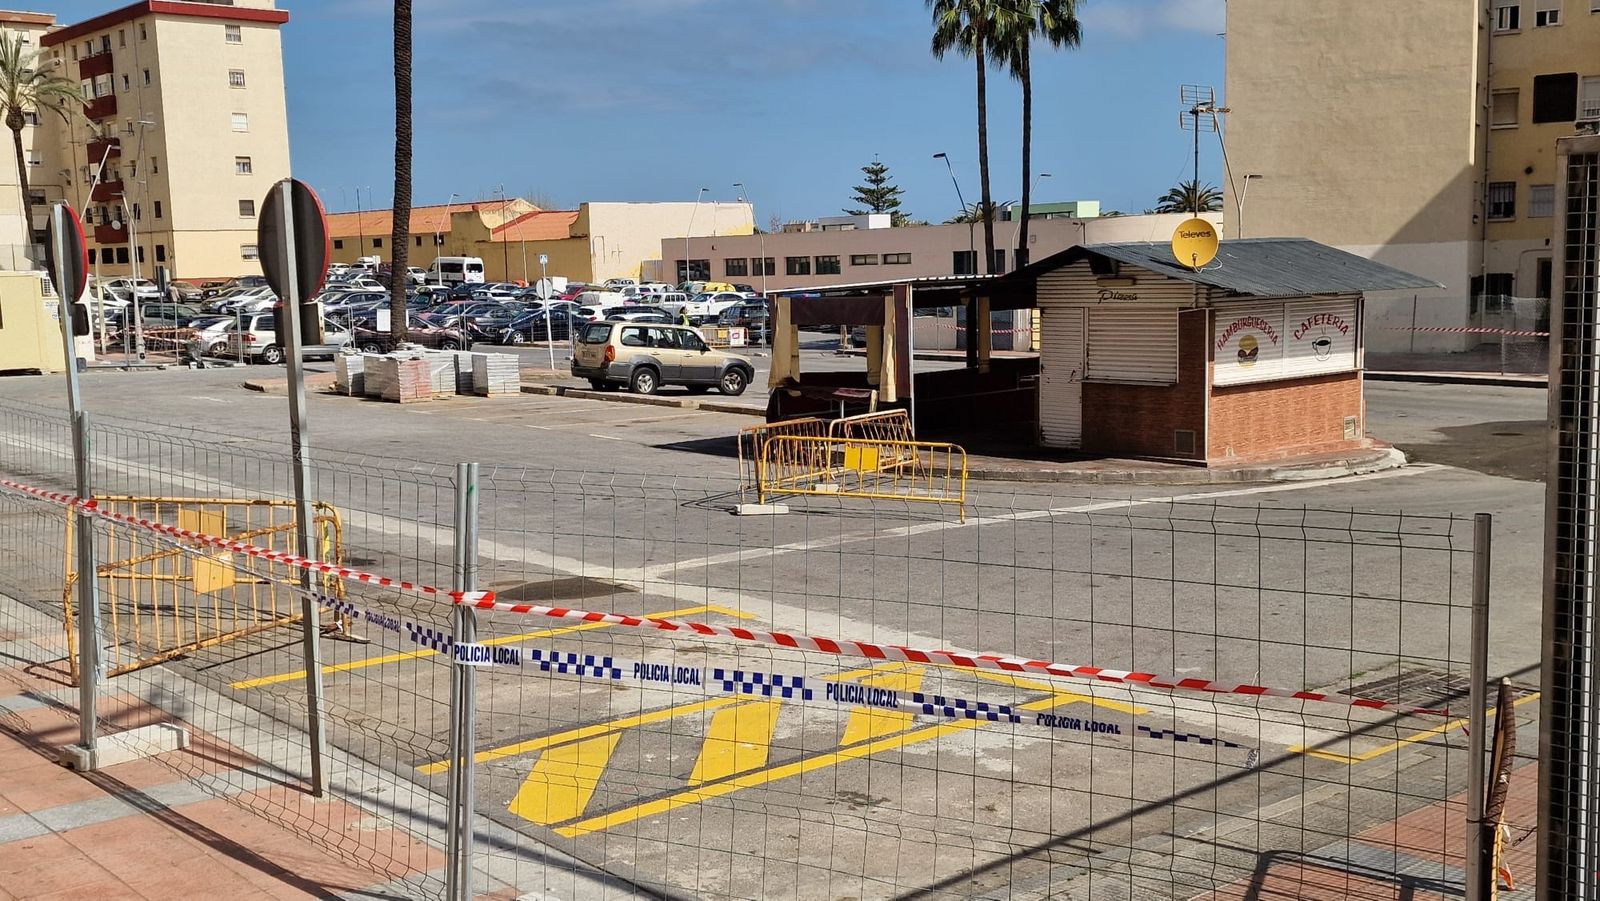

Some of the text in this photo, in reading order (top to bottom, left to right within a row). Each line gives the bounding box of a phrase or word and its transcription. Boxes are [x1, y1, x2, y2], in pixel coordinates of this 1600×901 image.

[1178, 230, 1212, 239] Televes
[1293, 313, 1350, 340] CAFETERIA
[454, 644, 520, 666] POLICIA LOCAL
[633, 662, 701, 686] POLICIA LOCAL
[826, 683, 898, 708] POLICIA LOCAL
